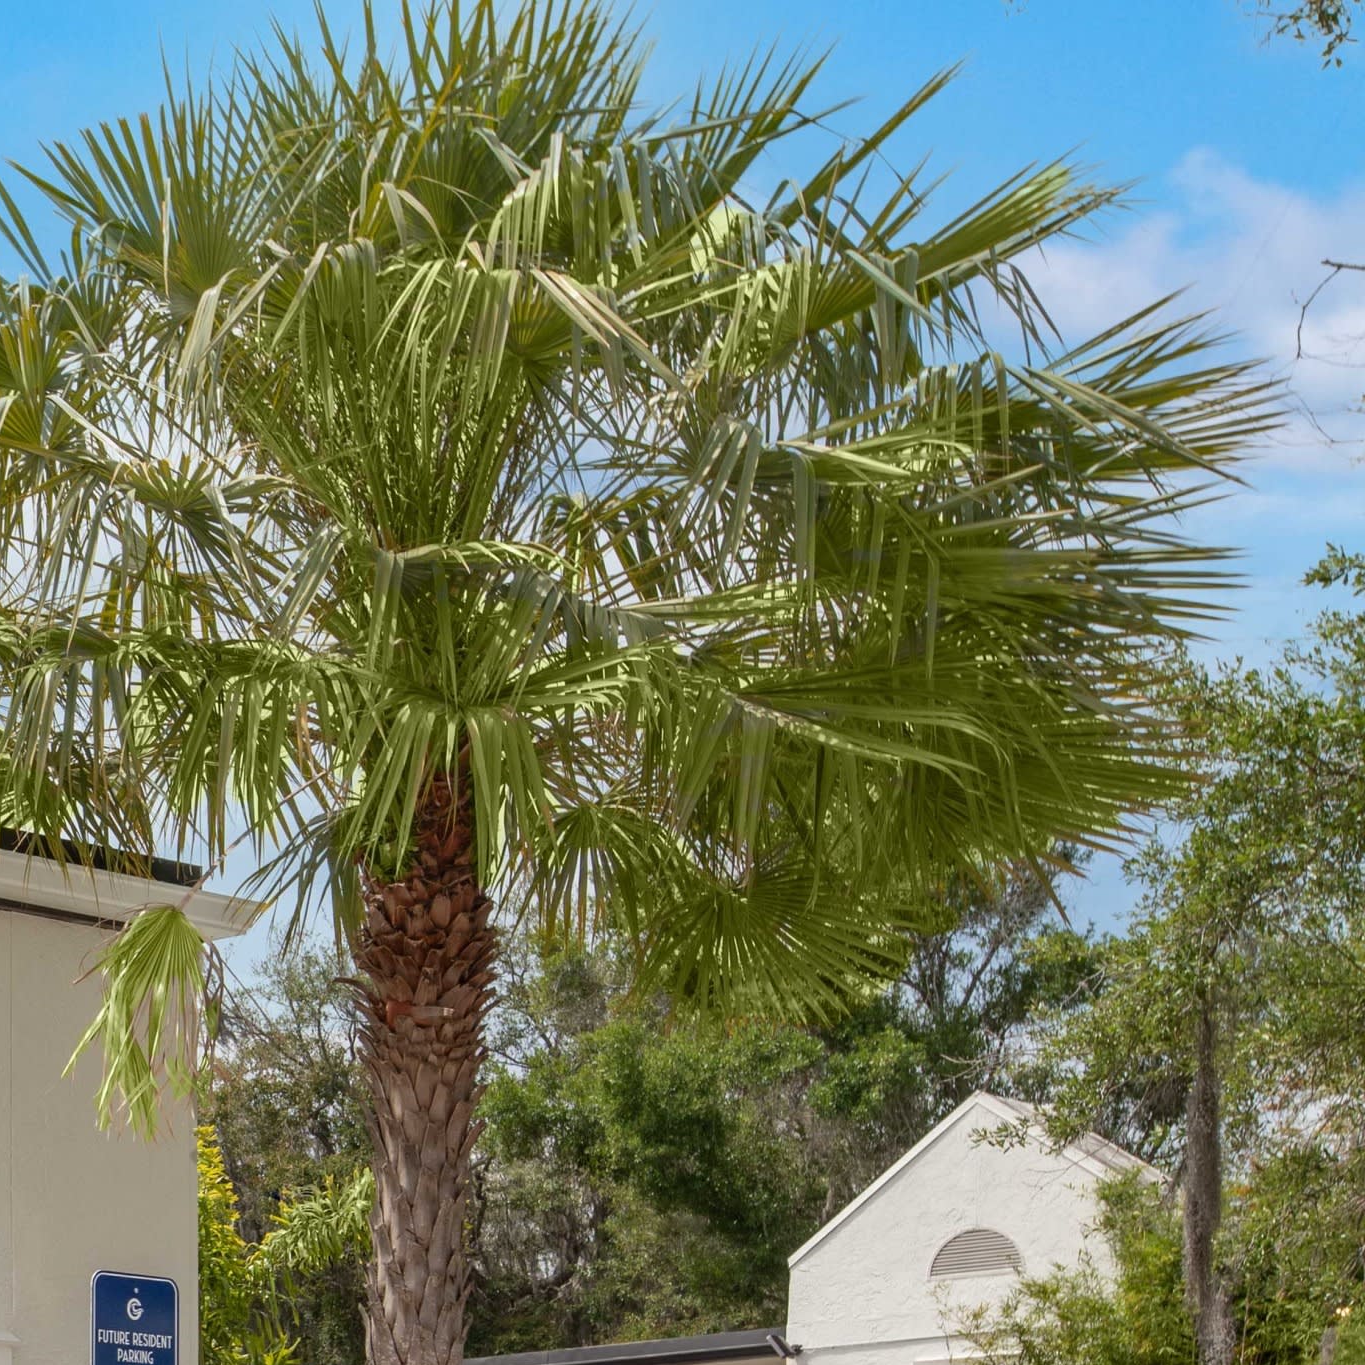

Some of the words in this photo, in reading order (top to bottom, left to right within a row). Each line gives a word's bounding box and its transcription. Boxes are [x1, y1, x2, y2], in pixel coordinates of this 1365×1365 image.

[97, 1328, 131, 1346] FUTURE
[132, 1331, 173, 1349] RESIDENT
[117, 1348, 154, 1365] PARKING
